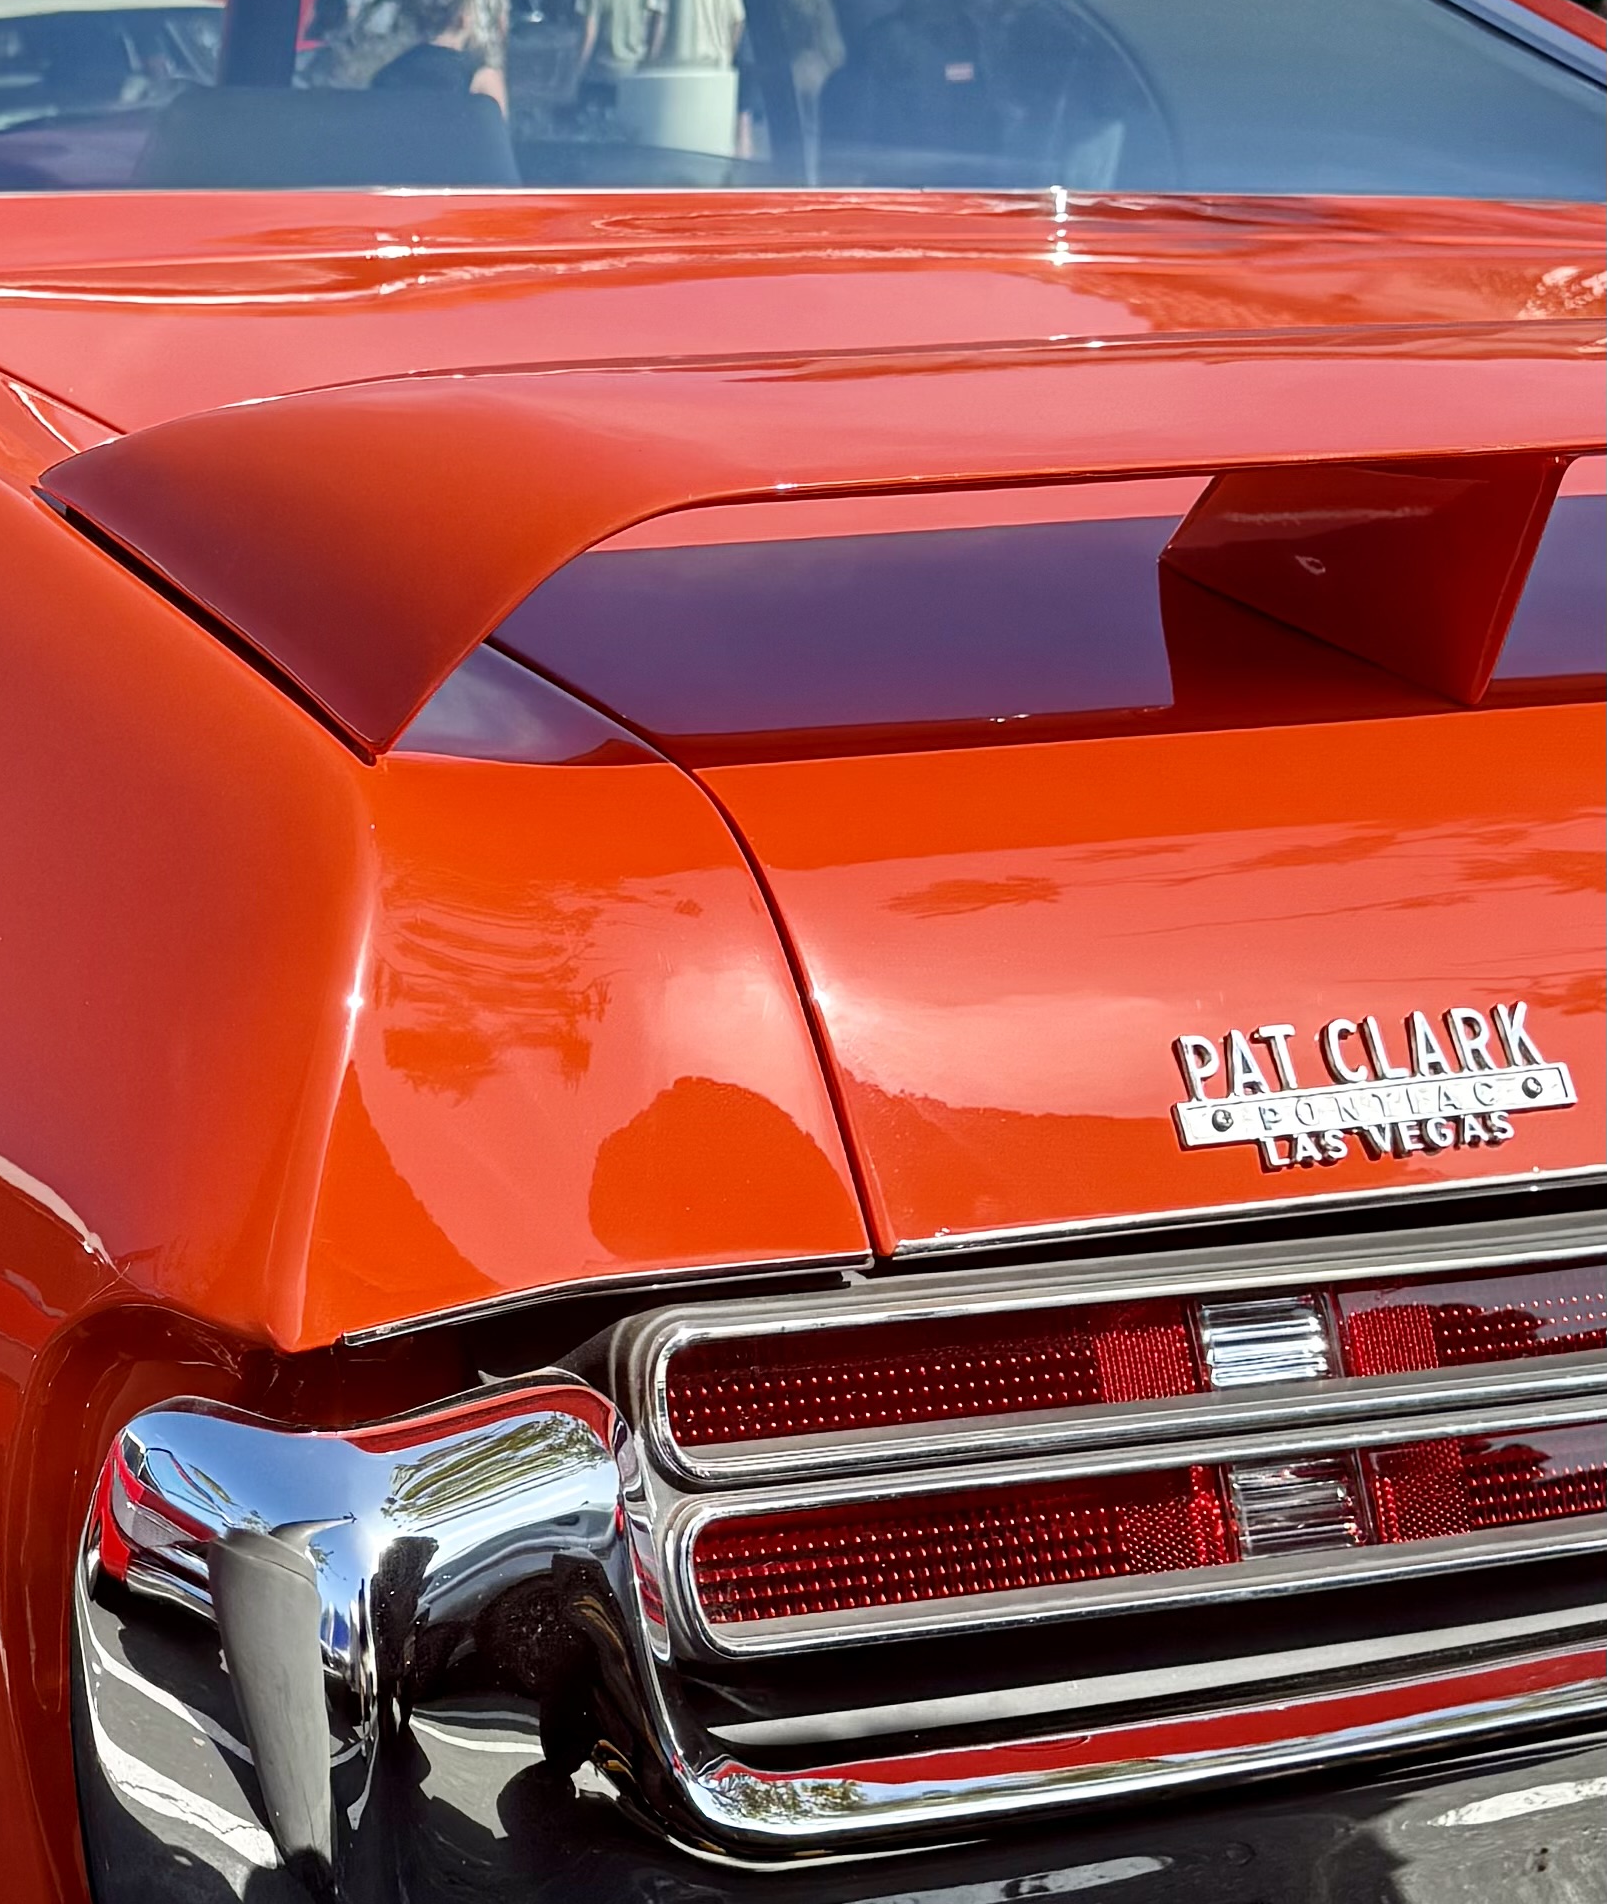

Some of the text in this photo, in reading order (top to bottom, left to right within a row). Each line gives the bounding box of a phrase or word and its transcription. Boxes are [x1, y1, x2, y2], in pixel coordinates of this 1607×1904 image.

[1174, 1001, 1543, 1100] PAT CLARK
[1258, 1081, 1496, 1131] PONTIAC
[1260, 1110, 1515, 1169] LAS VEGAS
